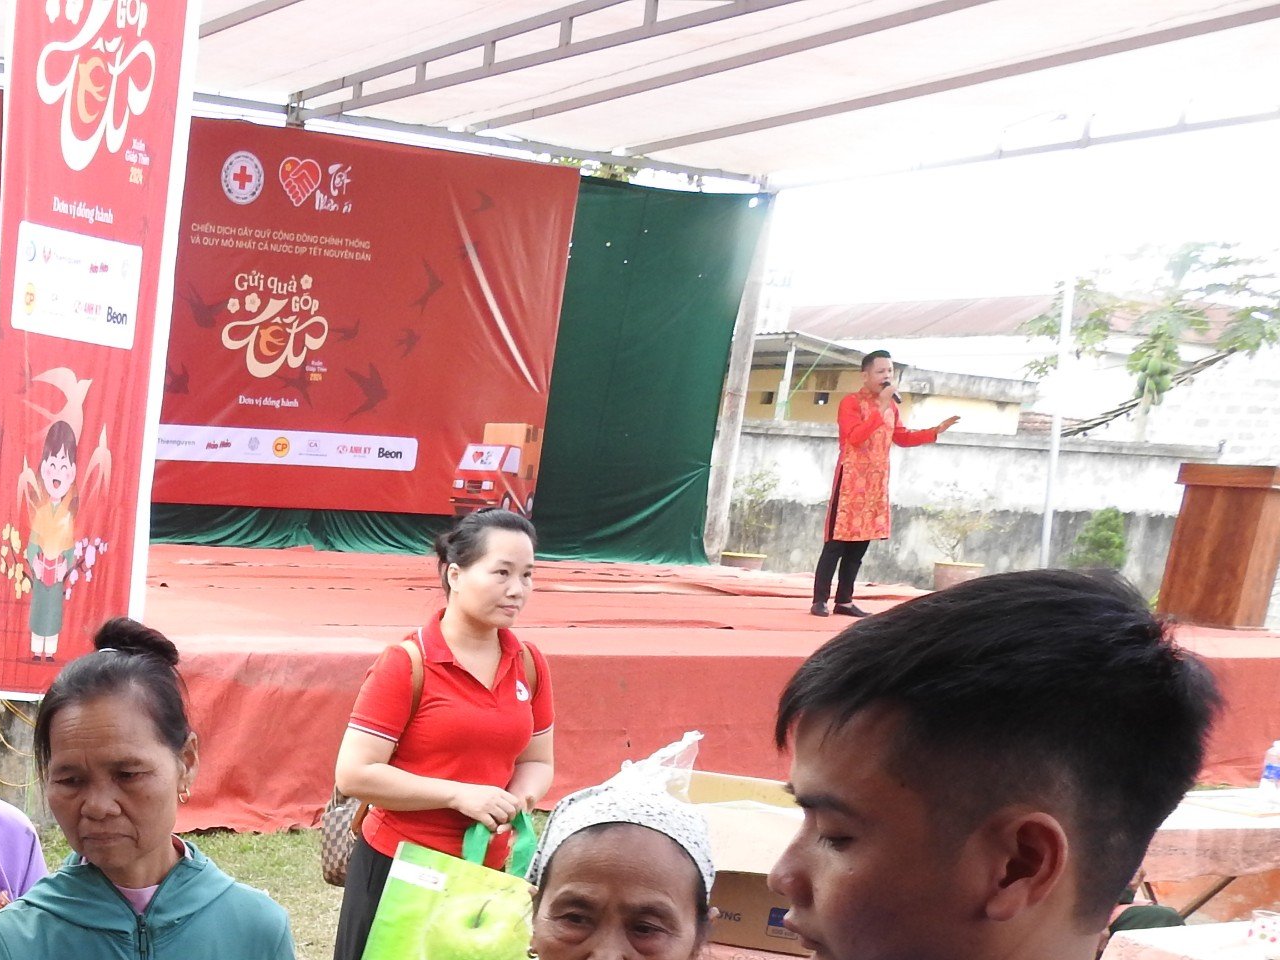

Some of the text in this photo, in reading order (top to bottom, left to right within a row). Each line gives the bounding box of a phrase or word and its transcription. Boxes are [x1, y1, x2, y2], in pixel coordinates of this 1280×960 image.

[69, 201, 77, 219] vị
[95, 205, 114, 224] hành
[216, 226, 236, 236] DỊCH
[202, 237, 220, 246] QUY
[235, 270, 297, 294] Gửi quà
[107, 306, 128, 325] Beon
[238, 395, 254, 405] Đơn
[255, 397, 262, 407] vị
[281, 398, 299, 407] hành
[274, 442, 288, 452] CP
[378, 447, 402, 460] Beon
